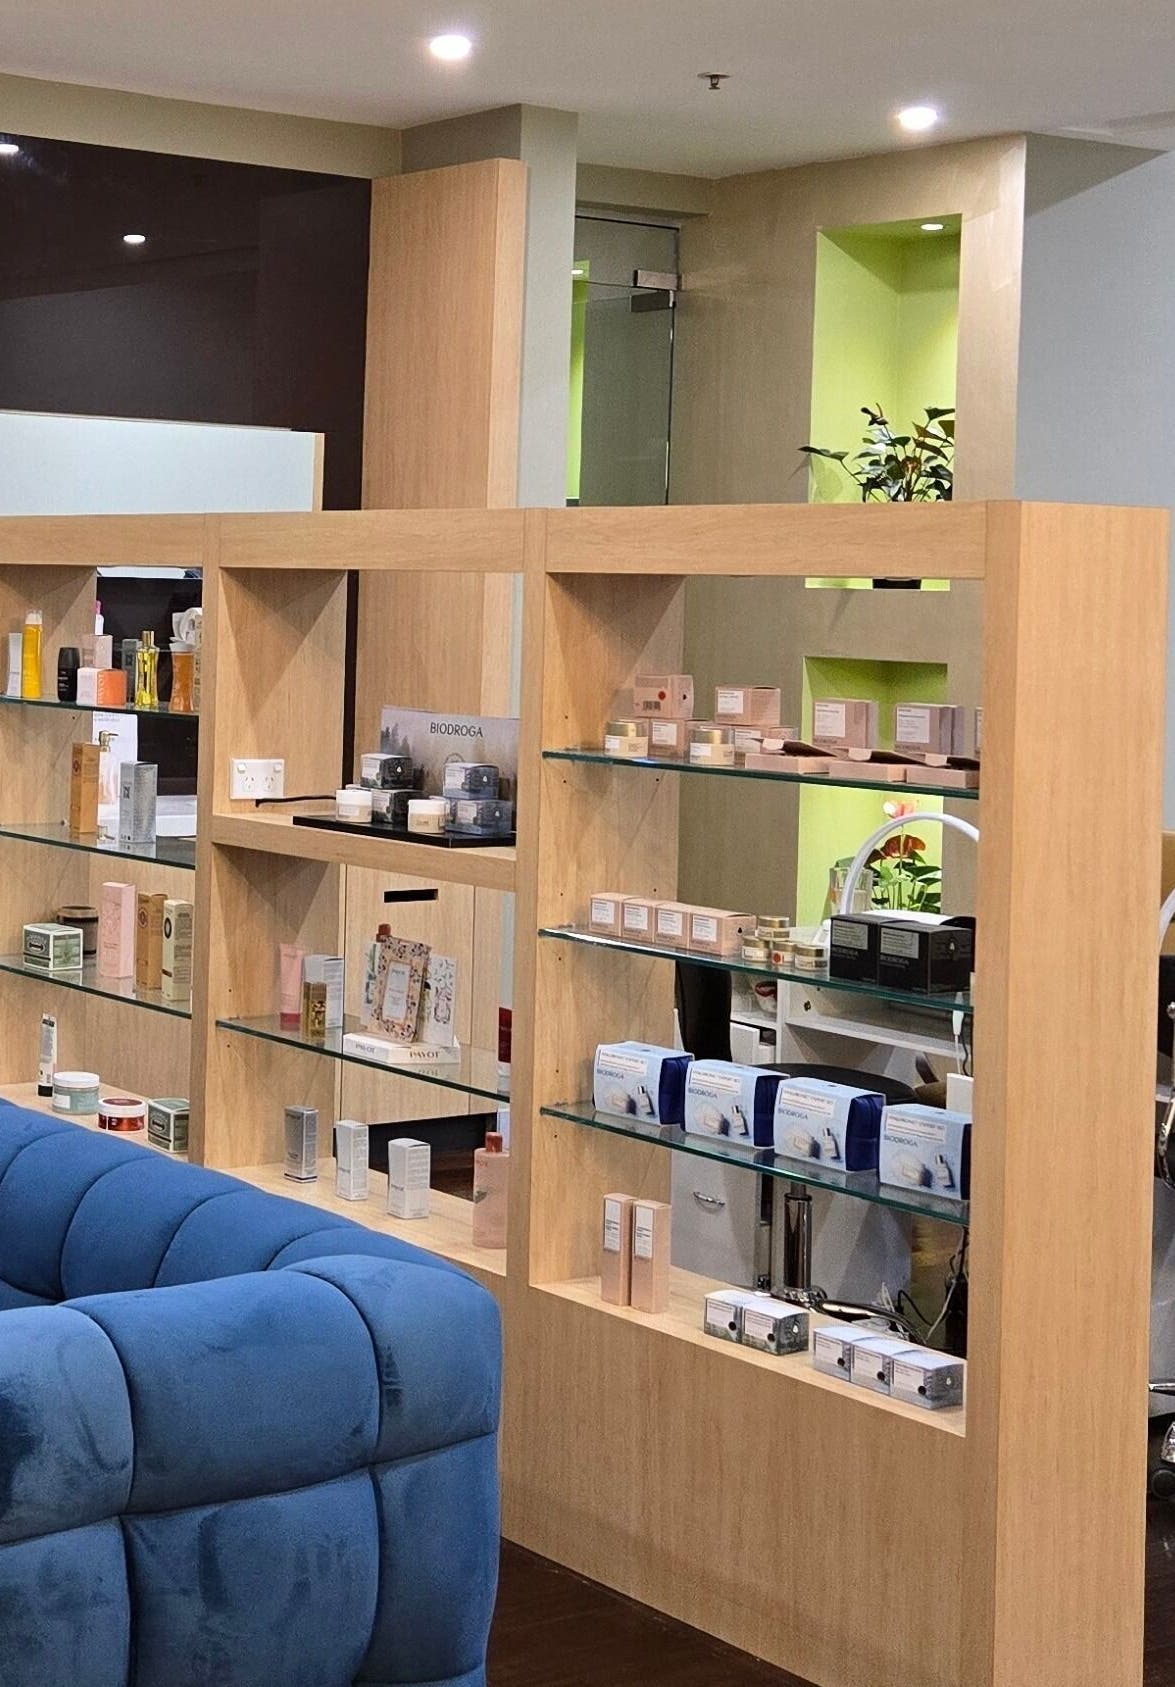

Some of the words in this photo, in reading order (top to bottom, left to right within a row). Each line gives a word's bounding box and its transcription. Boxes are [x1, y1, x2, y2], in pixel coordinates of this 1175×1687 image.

[430, 722, 484, 738] BIODROGA
[355, 1042, 376, 1054] PAYOT
[409, 1051, 440, 1059] PAYOT
